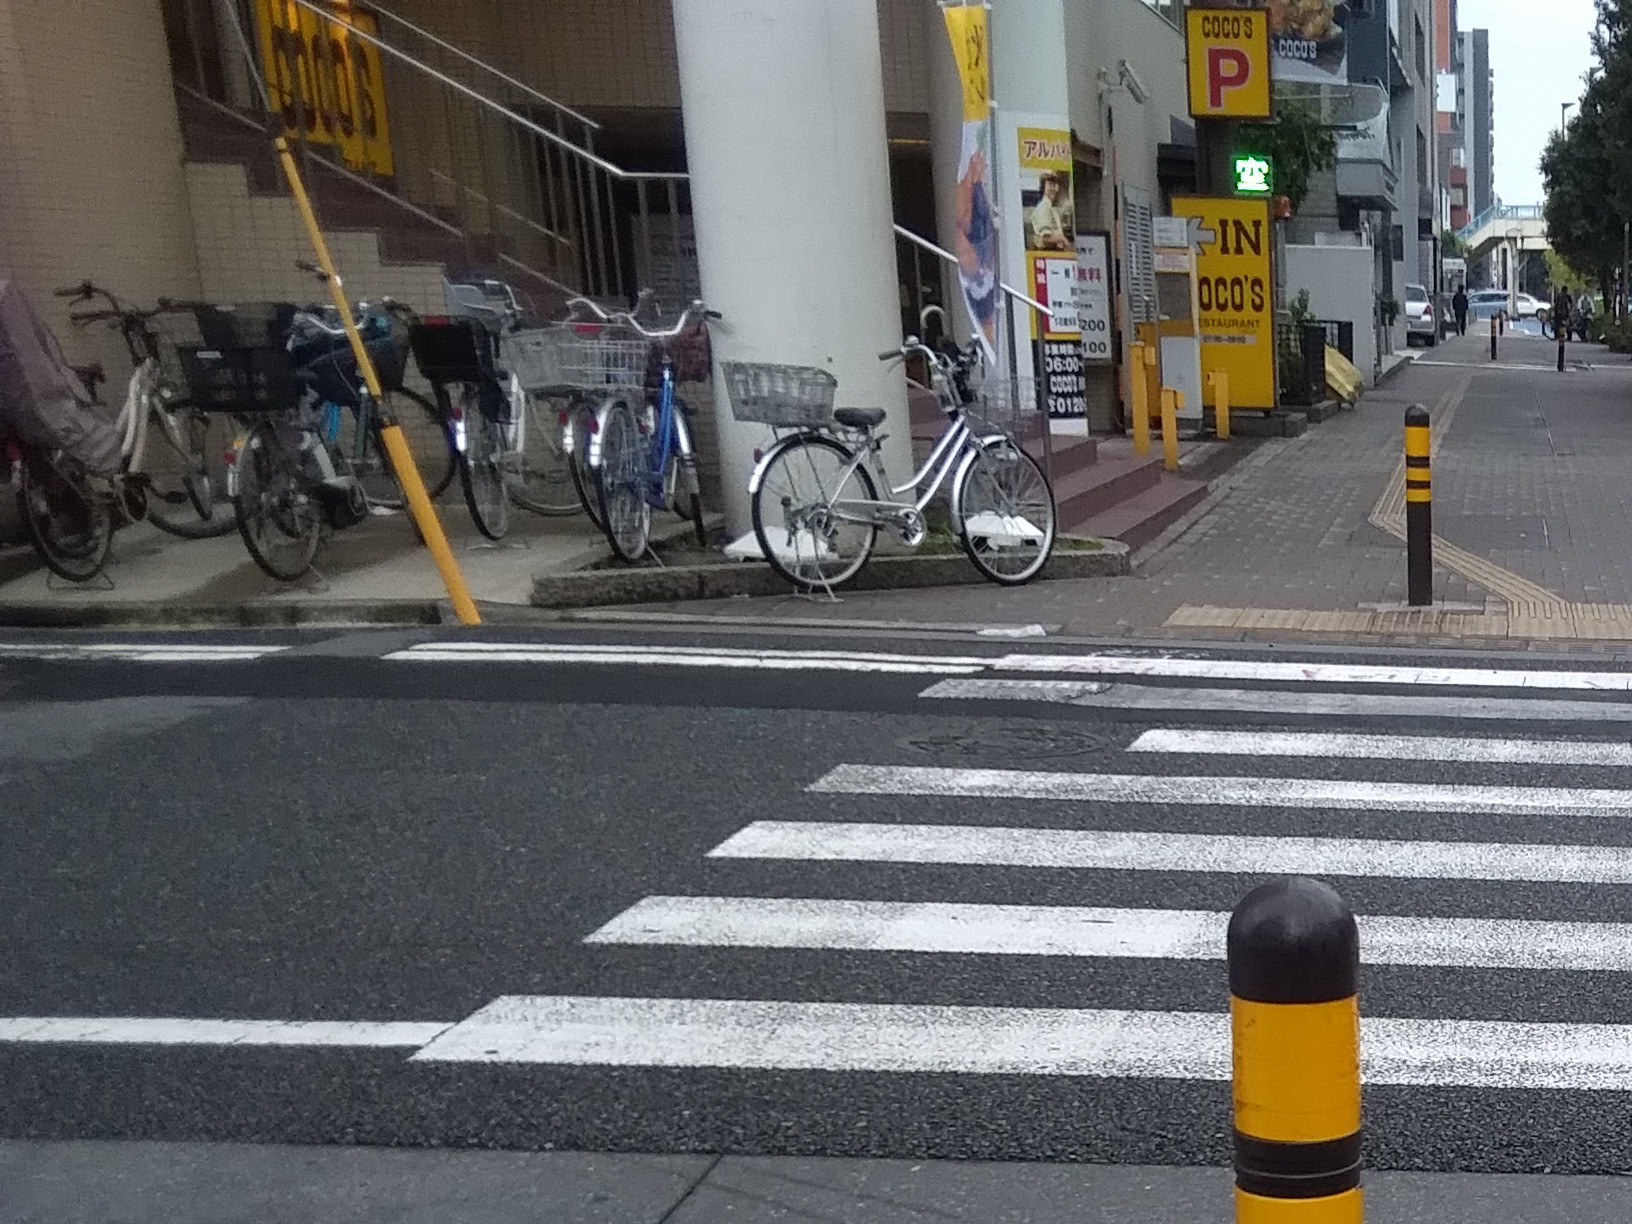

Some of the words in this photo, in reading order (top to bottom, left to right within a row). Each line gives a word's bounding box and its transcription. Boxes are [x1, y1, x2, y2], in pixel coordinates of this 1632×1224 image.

[1201, 15, 1253, 39] COCO'S
[1278, 38, 1318, 59] COCO'S
[1207, 47, 1250, 108] P
[1219, 218, 1262, 256] IN
[1199, 275, 1265, 313] OCO'S
